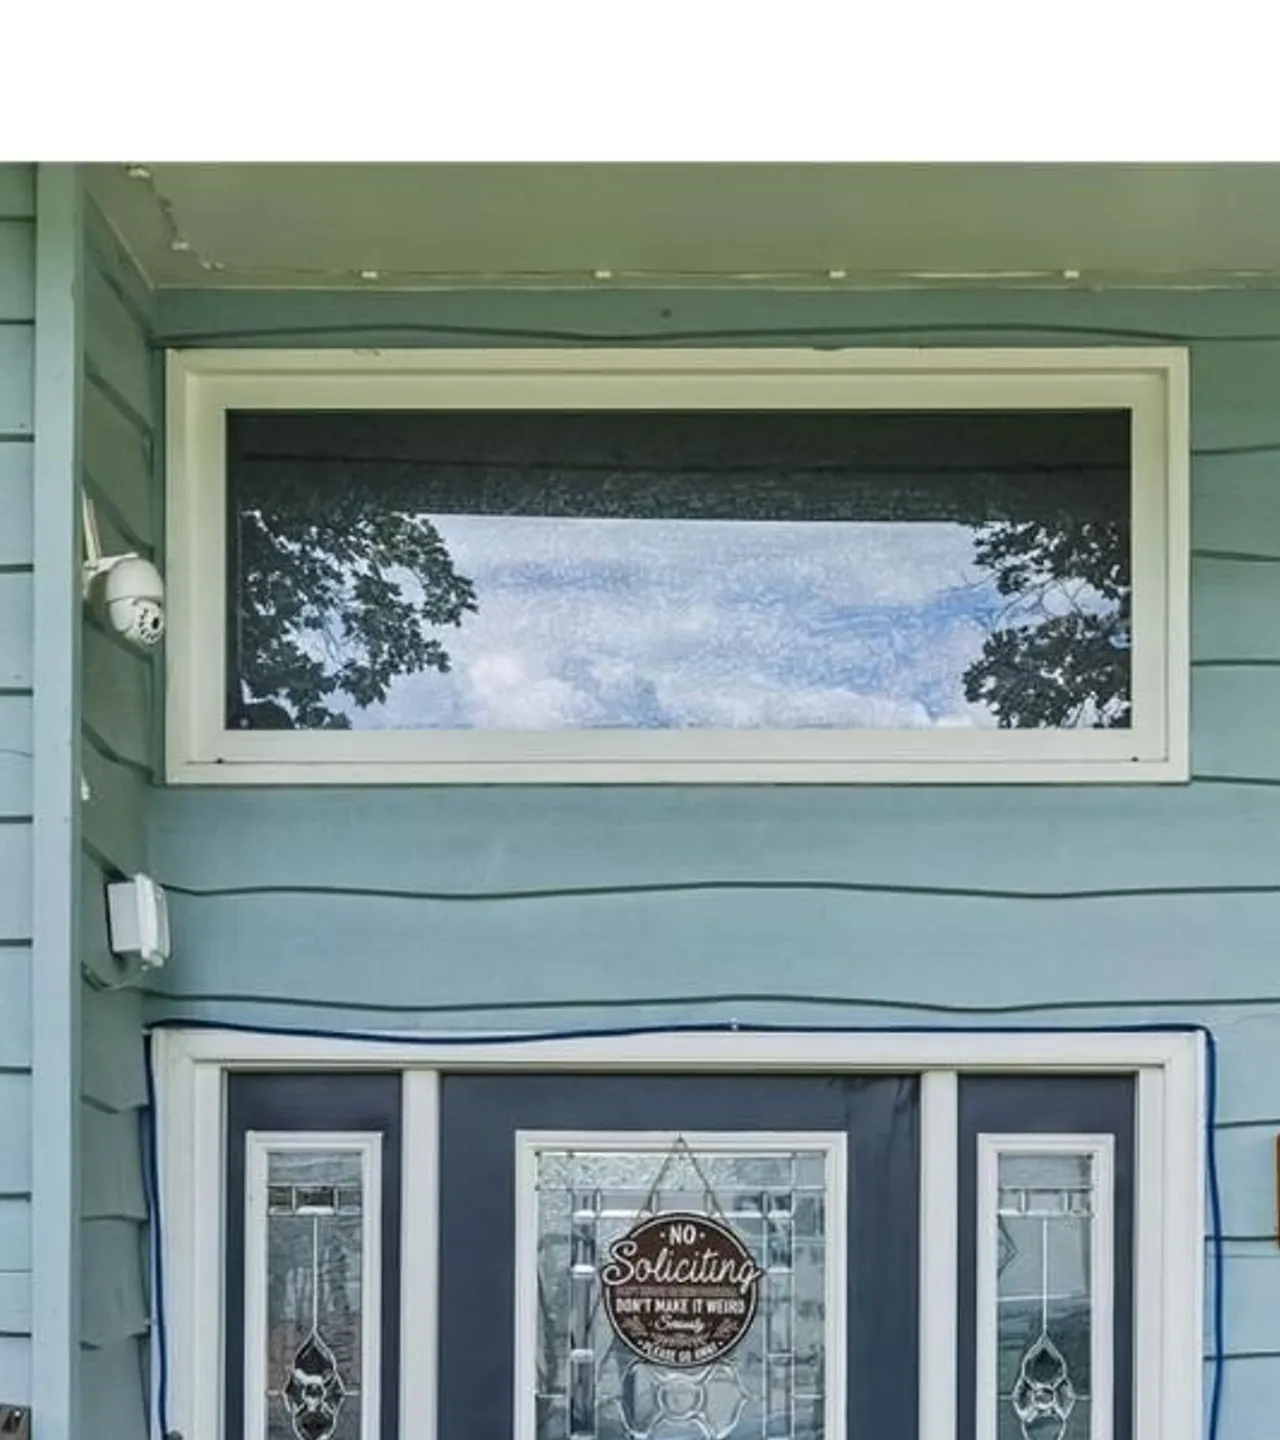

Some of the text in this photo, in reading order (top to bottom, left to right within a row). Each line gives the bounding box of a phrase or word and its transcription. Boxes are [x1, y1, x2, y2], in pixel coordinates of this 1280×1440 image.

[669, 1223, 697, 1246] NO
[602, 1240, 762, 1295] Soliciting
[615, 1298, 746, 1315] DON'T MAKE IT WEIRD
